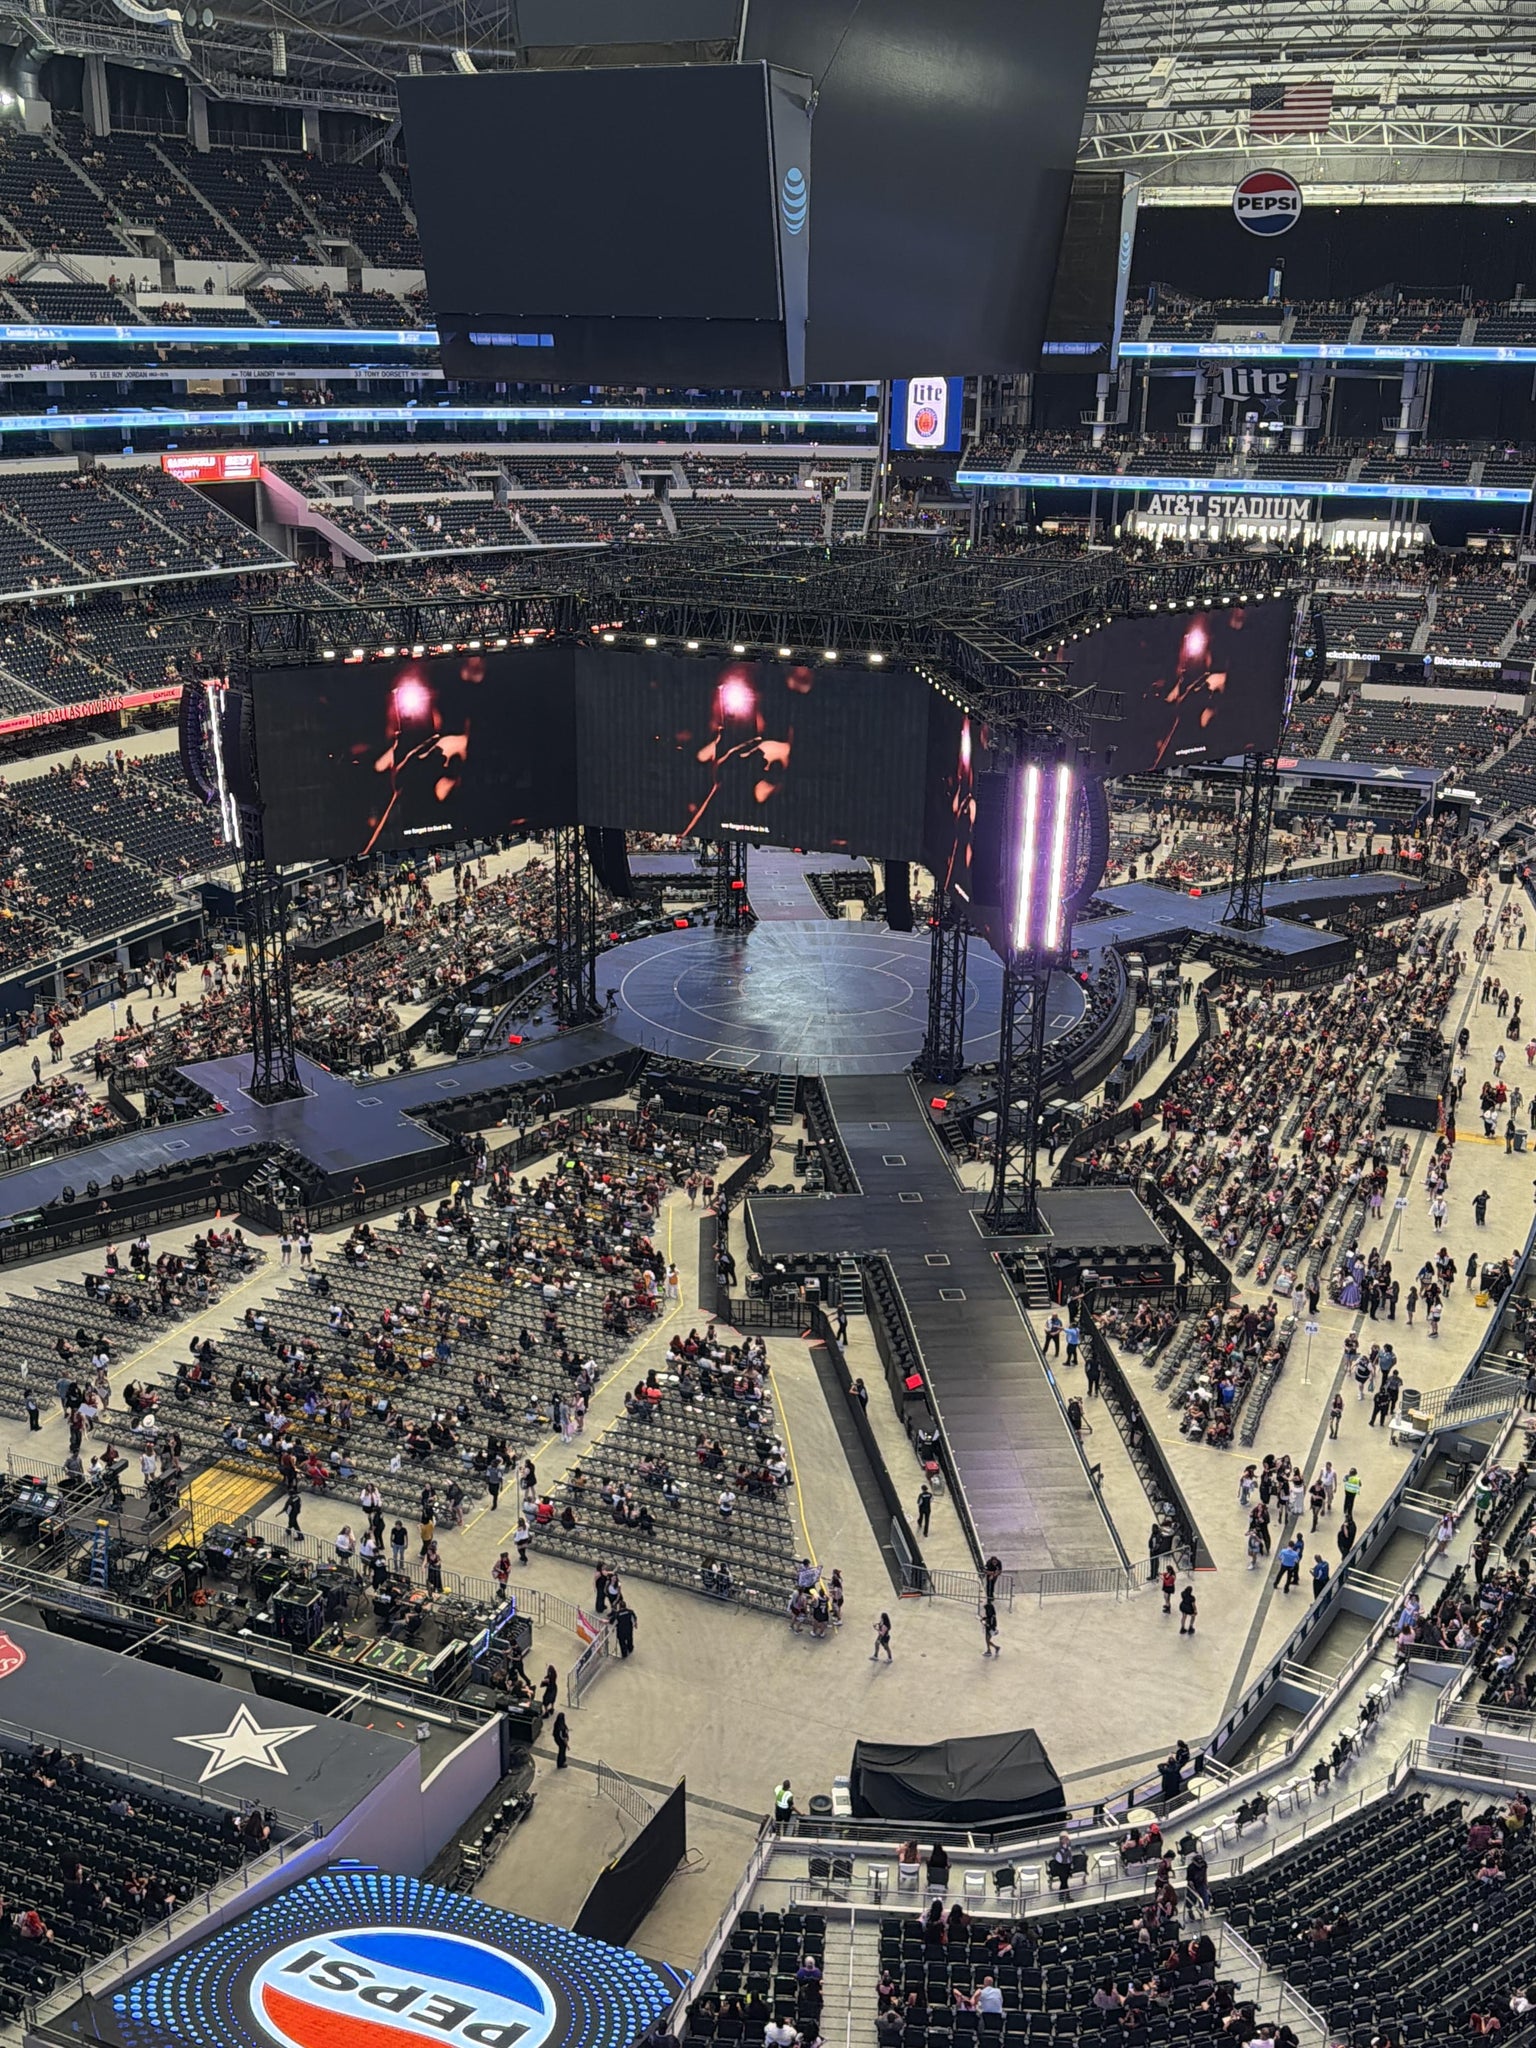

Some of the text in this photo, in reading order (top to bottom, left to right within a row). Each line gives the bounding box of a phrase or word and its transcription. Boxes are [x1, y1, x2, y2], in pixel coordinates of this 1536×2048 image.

[1238, 197, 1297, 210] PEPSI
[100, 371, 111, 379] LEE
[1220, 367, 1288, 401] Lite
[913, 384, 943, 405] Lite
[1147, 494, 1311, 520] AT&T STADIUM
[1433, 656, 1502, 668] Blockchain.com
[48, 704, 81, 724] DALLAS
[81, 697, 124, 717] COWBOYS
[280, 1950, 531, 2048] PEPSI
